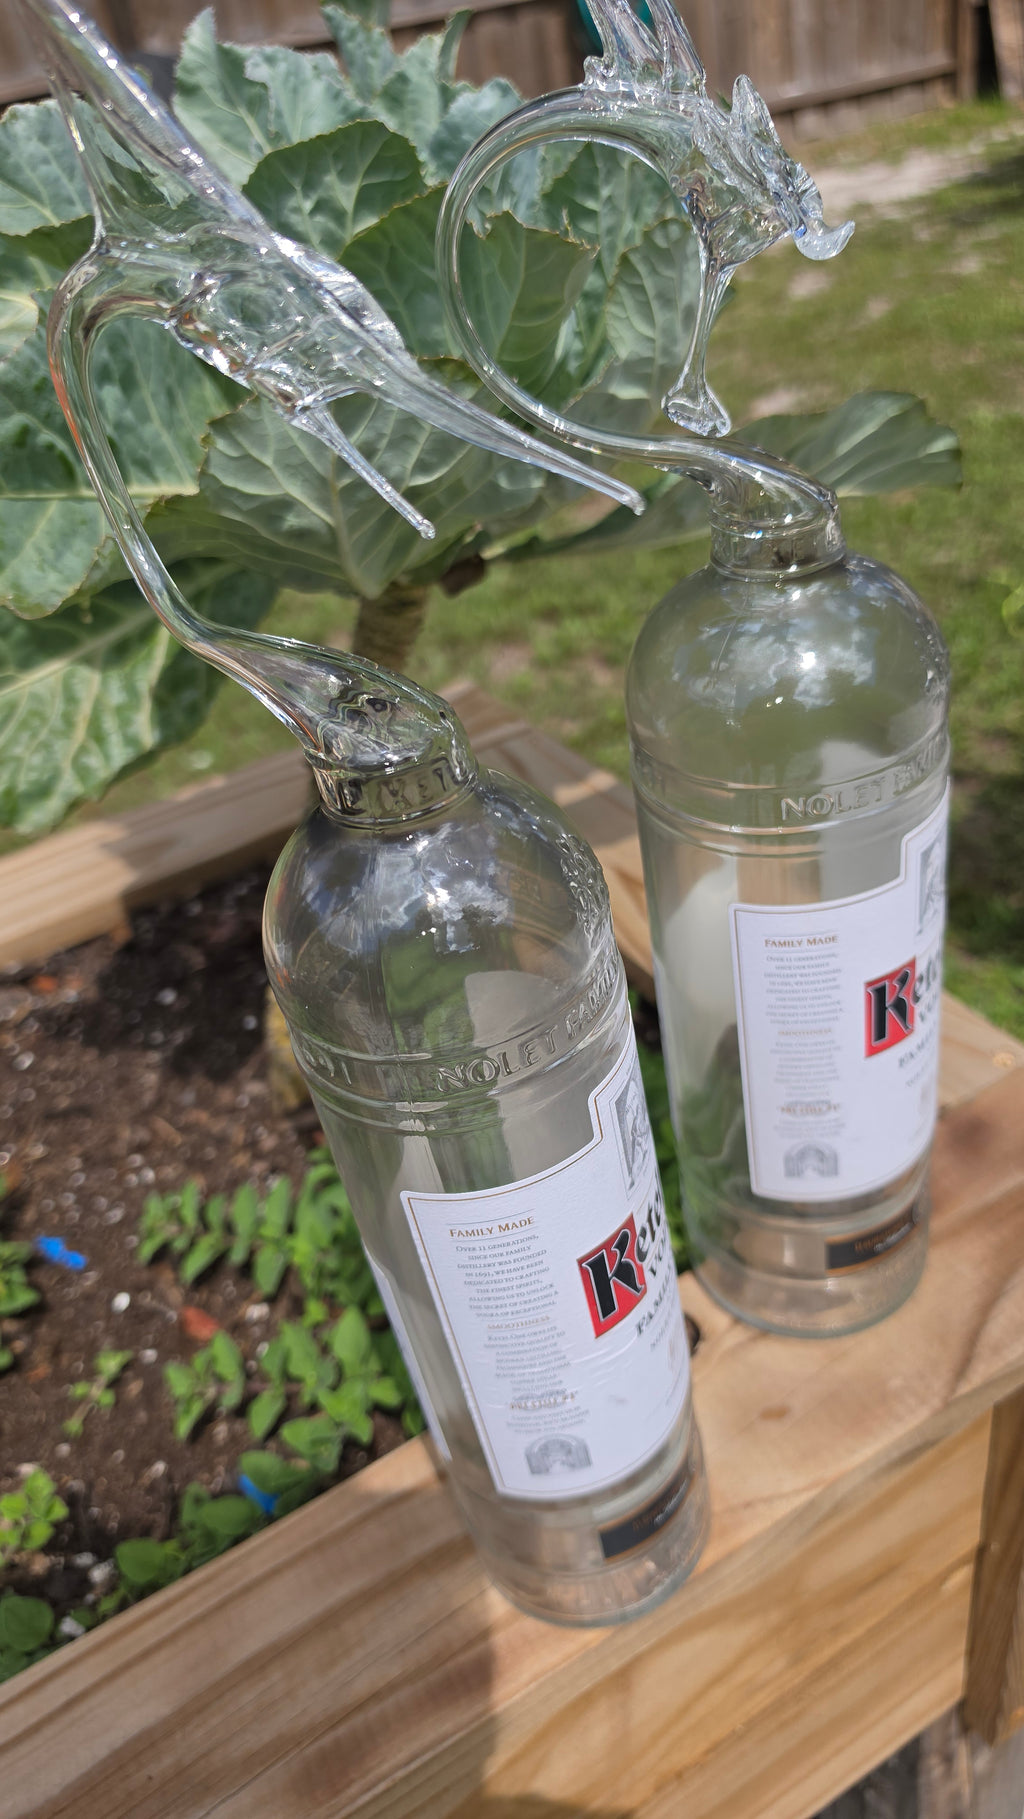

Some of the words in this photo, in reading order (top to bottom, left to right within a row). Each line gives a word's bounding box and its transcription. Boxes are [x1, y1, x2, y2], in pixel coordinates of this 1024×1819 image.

[780, 776, 886, 822] NOLET
[764, 938, 804, 949] FAMILY
[806, 935, 839, 947] MADE
[436, 1024, 559, 1094] NOLET
[449, 1226, 494, 1238] FAMILY
[497, 1215, 535, 1233] MADE
[456, 1245, 476, 1253] OVER
[478, 1244, 487, 1252] 11
[487, 1233, 539, 1250] GENERATIONS,
[489, 1252, 505, 1260] OUR
[505, 1244, 532, 1256] FAMILY
[497, 1258, 513, 1267] WAS
[513, 1248, 548, 1264] FOUNDED
[506, 1263, 525, 1274] HAVE
